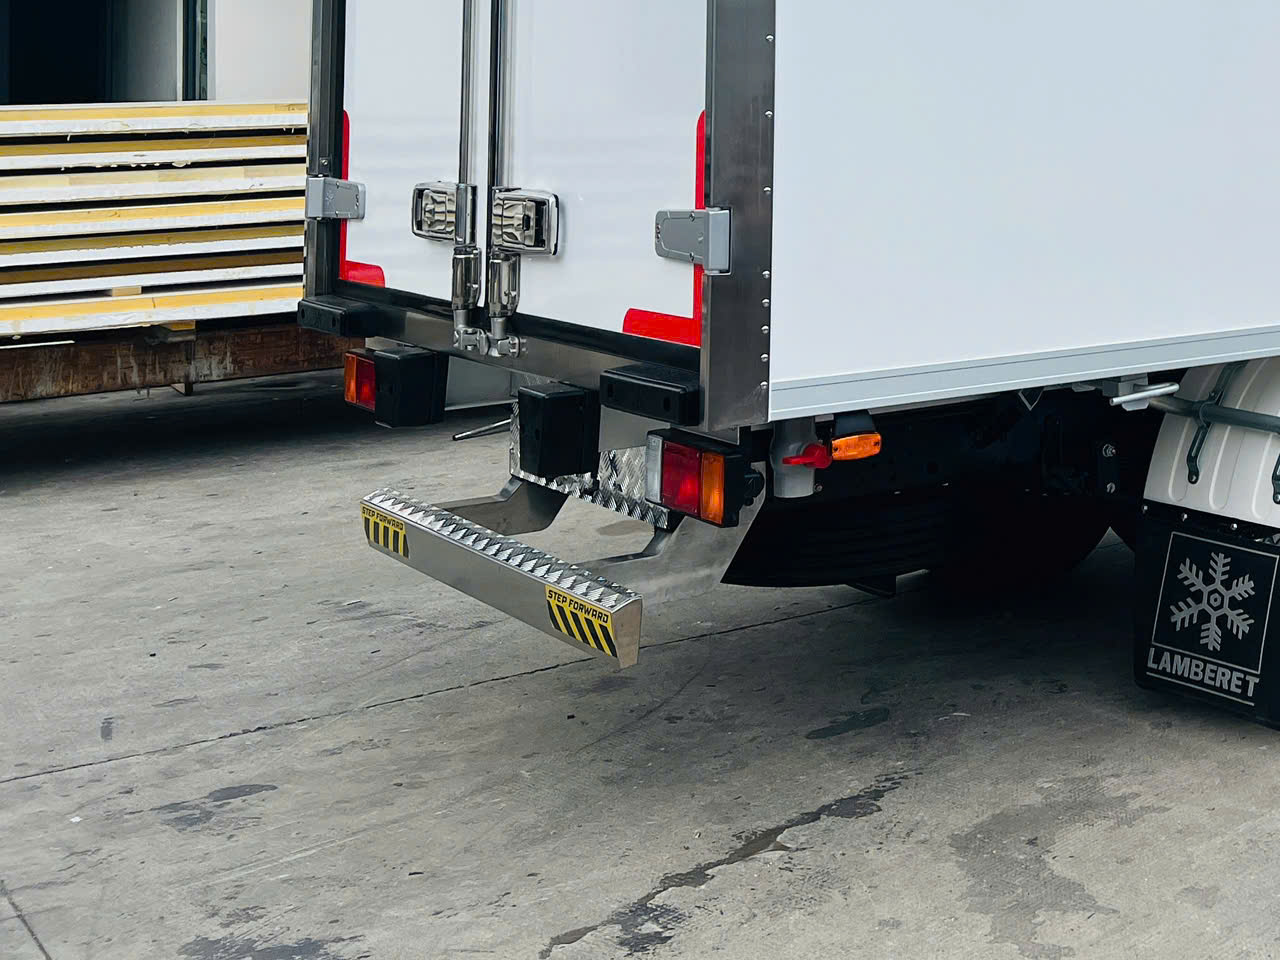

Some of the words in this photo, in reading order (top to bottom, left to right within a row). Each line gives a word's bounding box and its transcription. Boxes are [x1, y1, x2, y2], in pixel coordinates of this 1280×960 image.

[362, 506, 376, 517] STEP
[376, 512, 404, 530] FORWARD
[548, 590, 567, 604] STEP
[568, 598, 609, 624] FORWARD
[1147, 647, 1260, 697] LAMBERET
